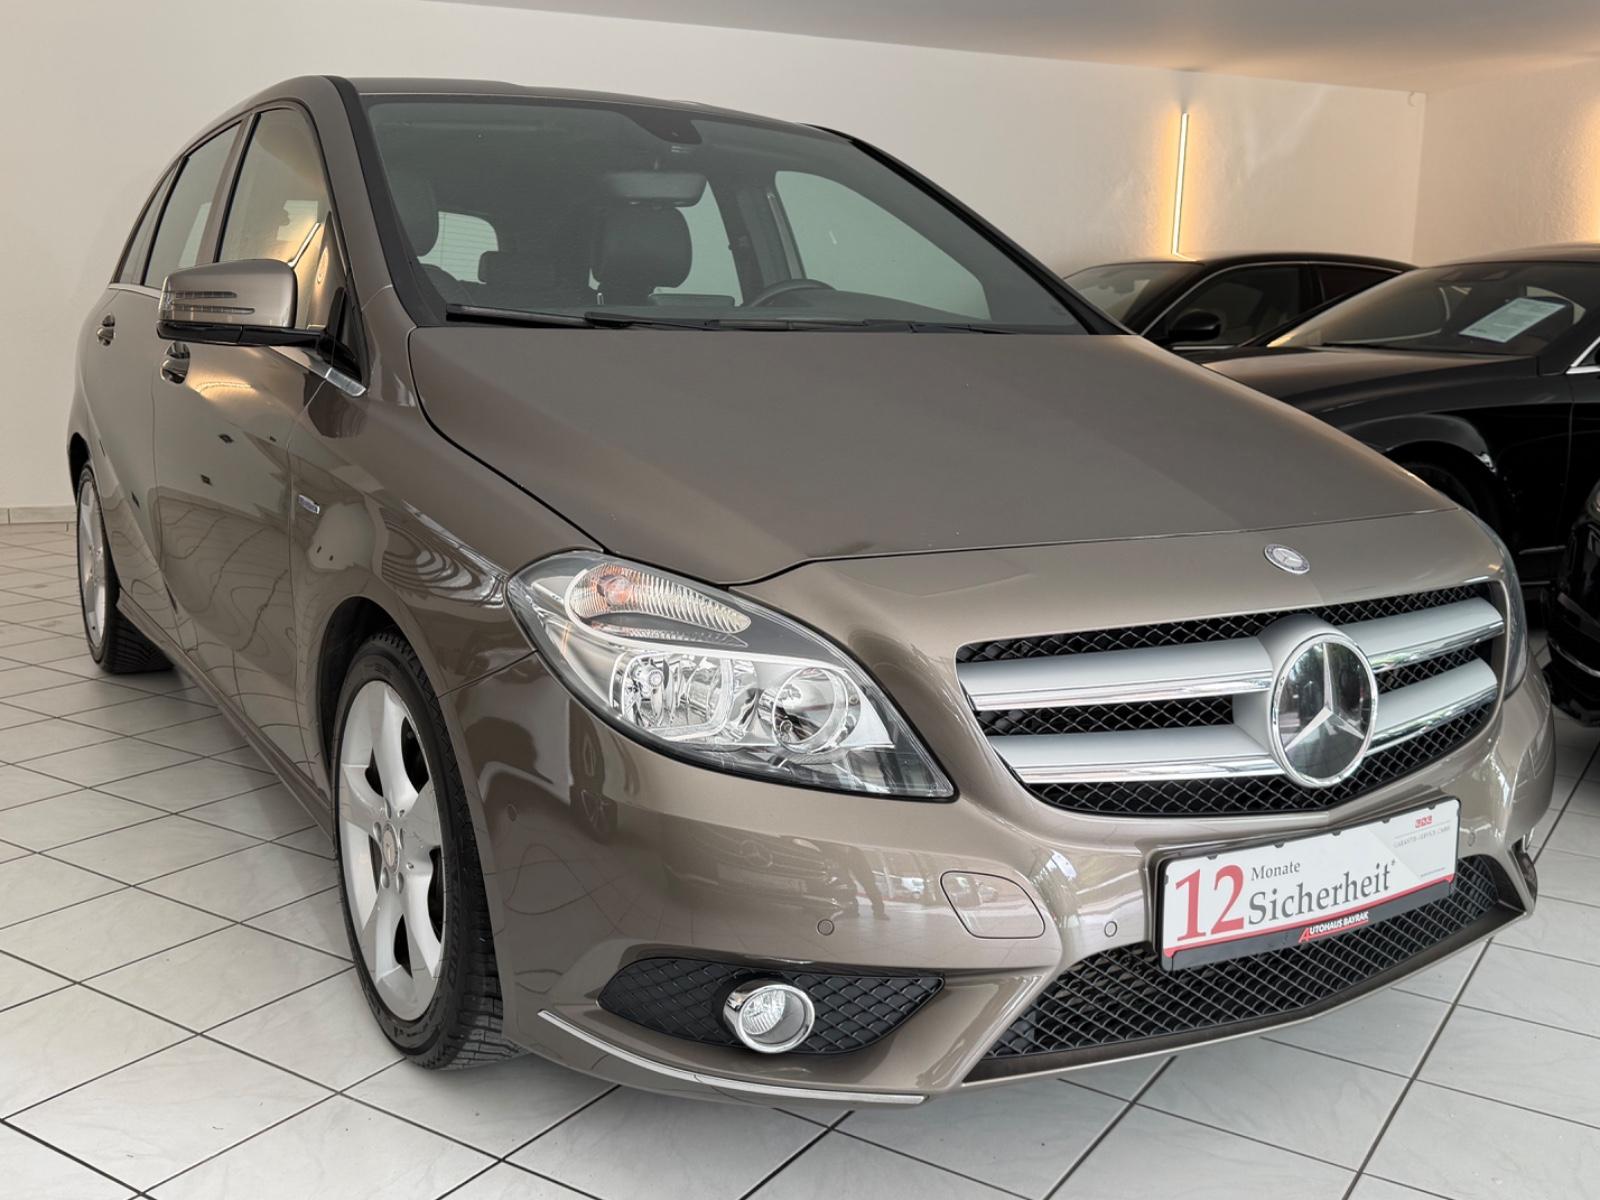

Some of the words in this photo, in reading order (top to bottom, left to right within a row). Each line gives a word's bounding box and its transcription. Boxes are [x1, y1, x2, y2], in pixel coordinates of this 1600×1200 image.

[1250, 859, 1301, 881] Monate
[1175, 863, 1245, 942] 12
[1298, 917, 1343, 944] AUTOHAUS
